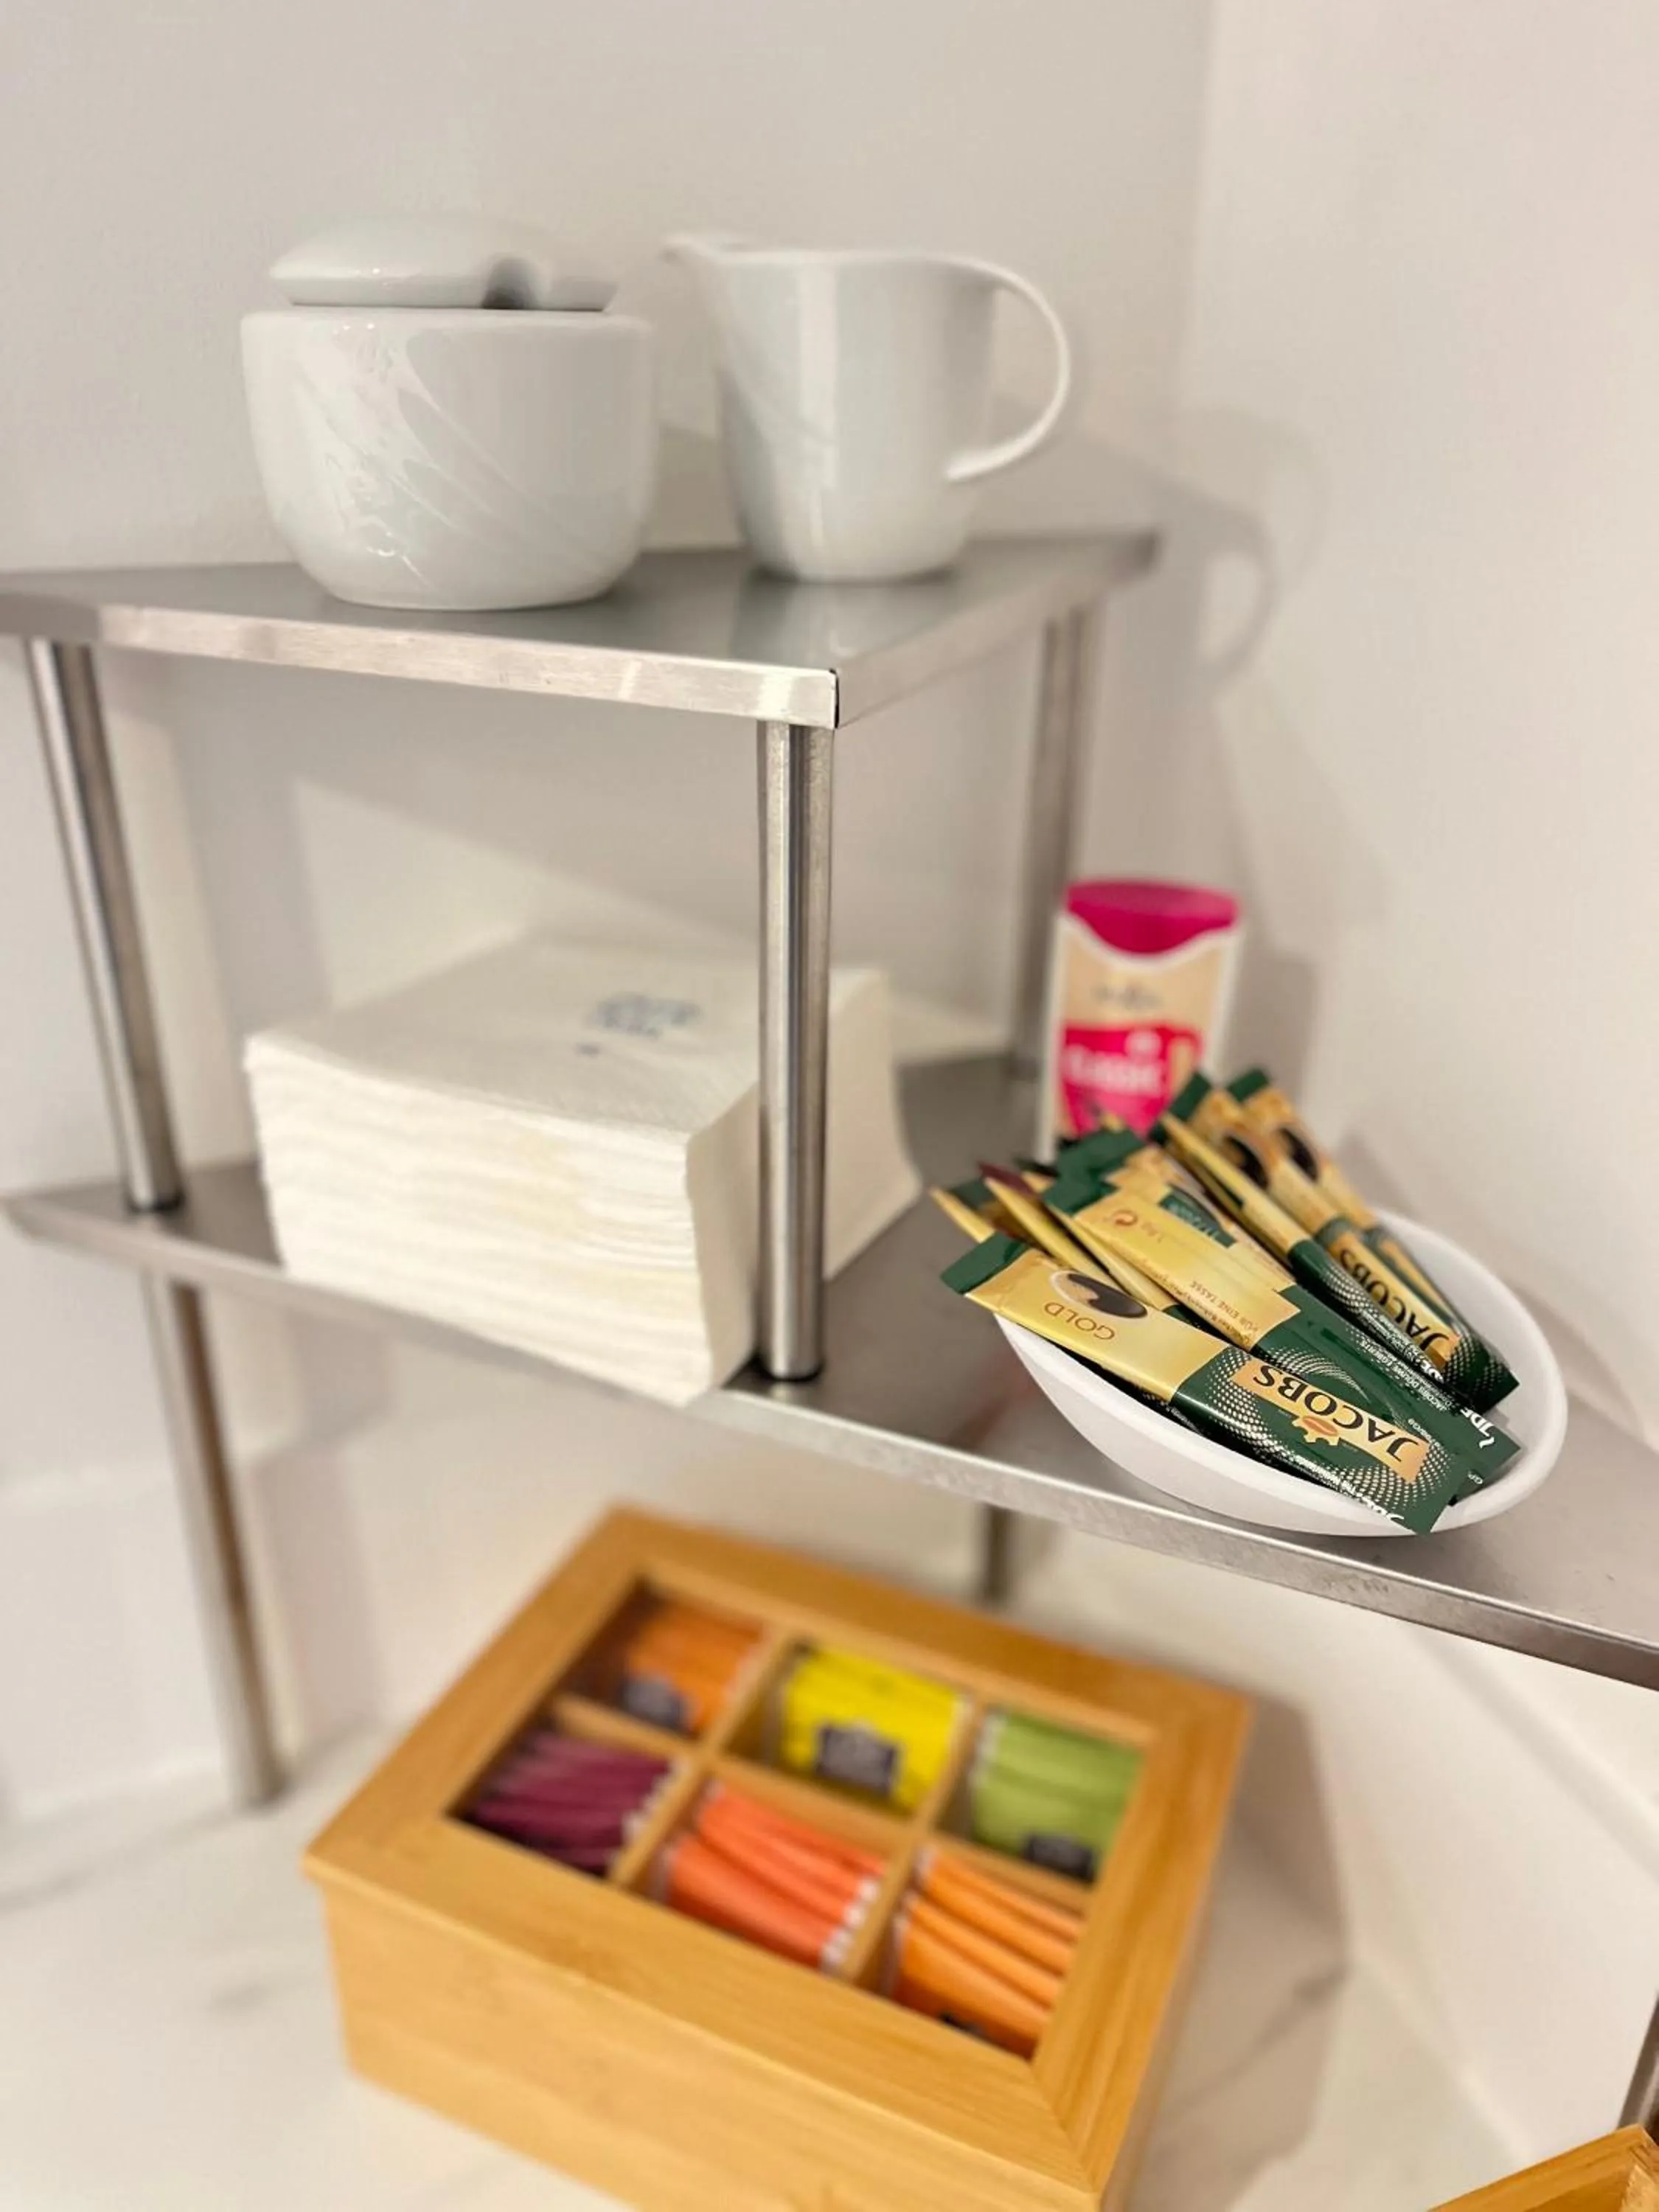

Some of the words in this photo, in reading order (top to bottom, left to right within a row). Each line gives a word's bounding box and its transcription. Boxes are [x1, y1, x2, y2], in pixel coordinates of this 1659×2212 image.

[1189, 1279, 1218, 1304] TASSE
[1044, 1302, 1115, 1340] GOLD
[1217, 1299, 1239, 1319] EINE
[1391, 1364, 1419, 1388] DOUWE
[1253, 1364, 1419, 1463] JACOBS
